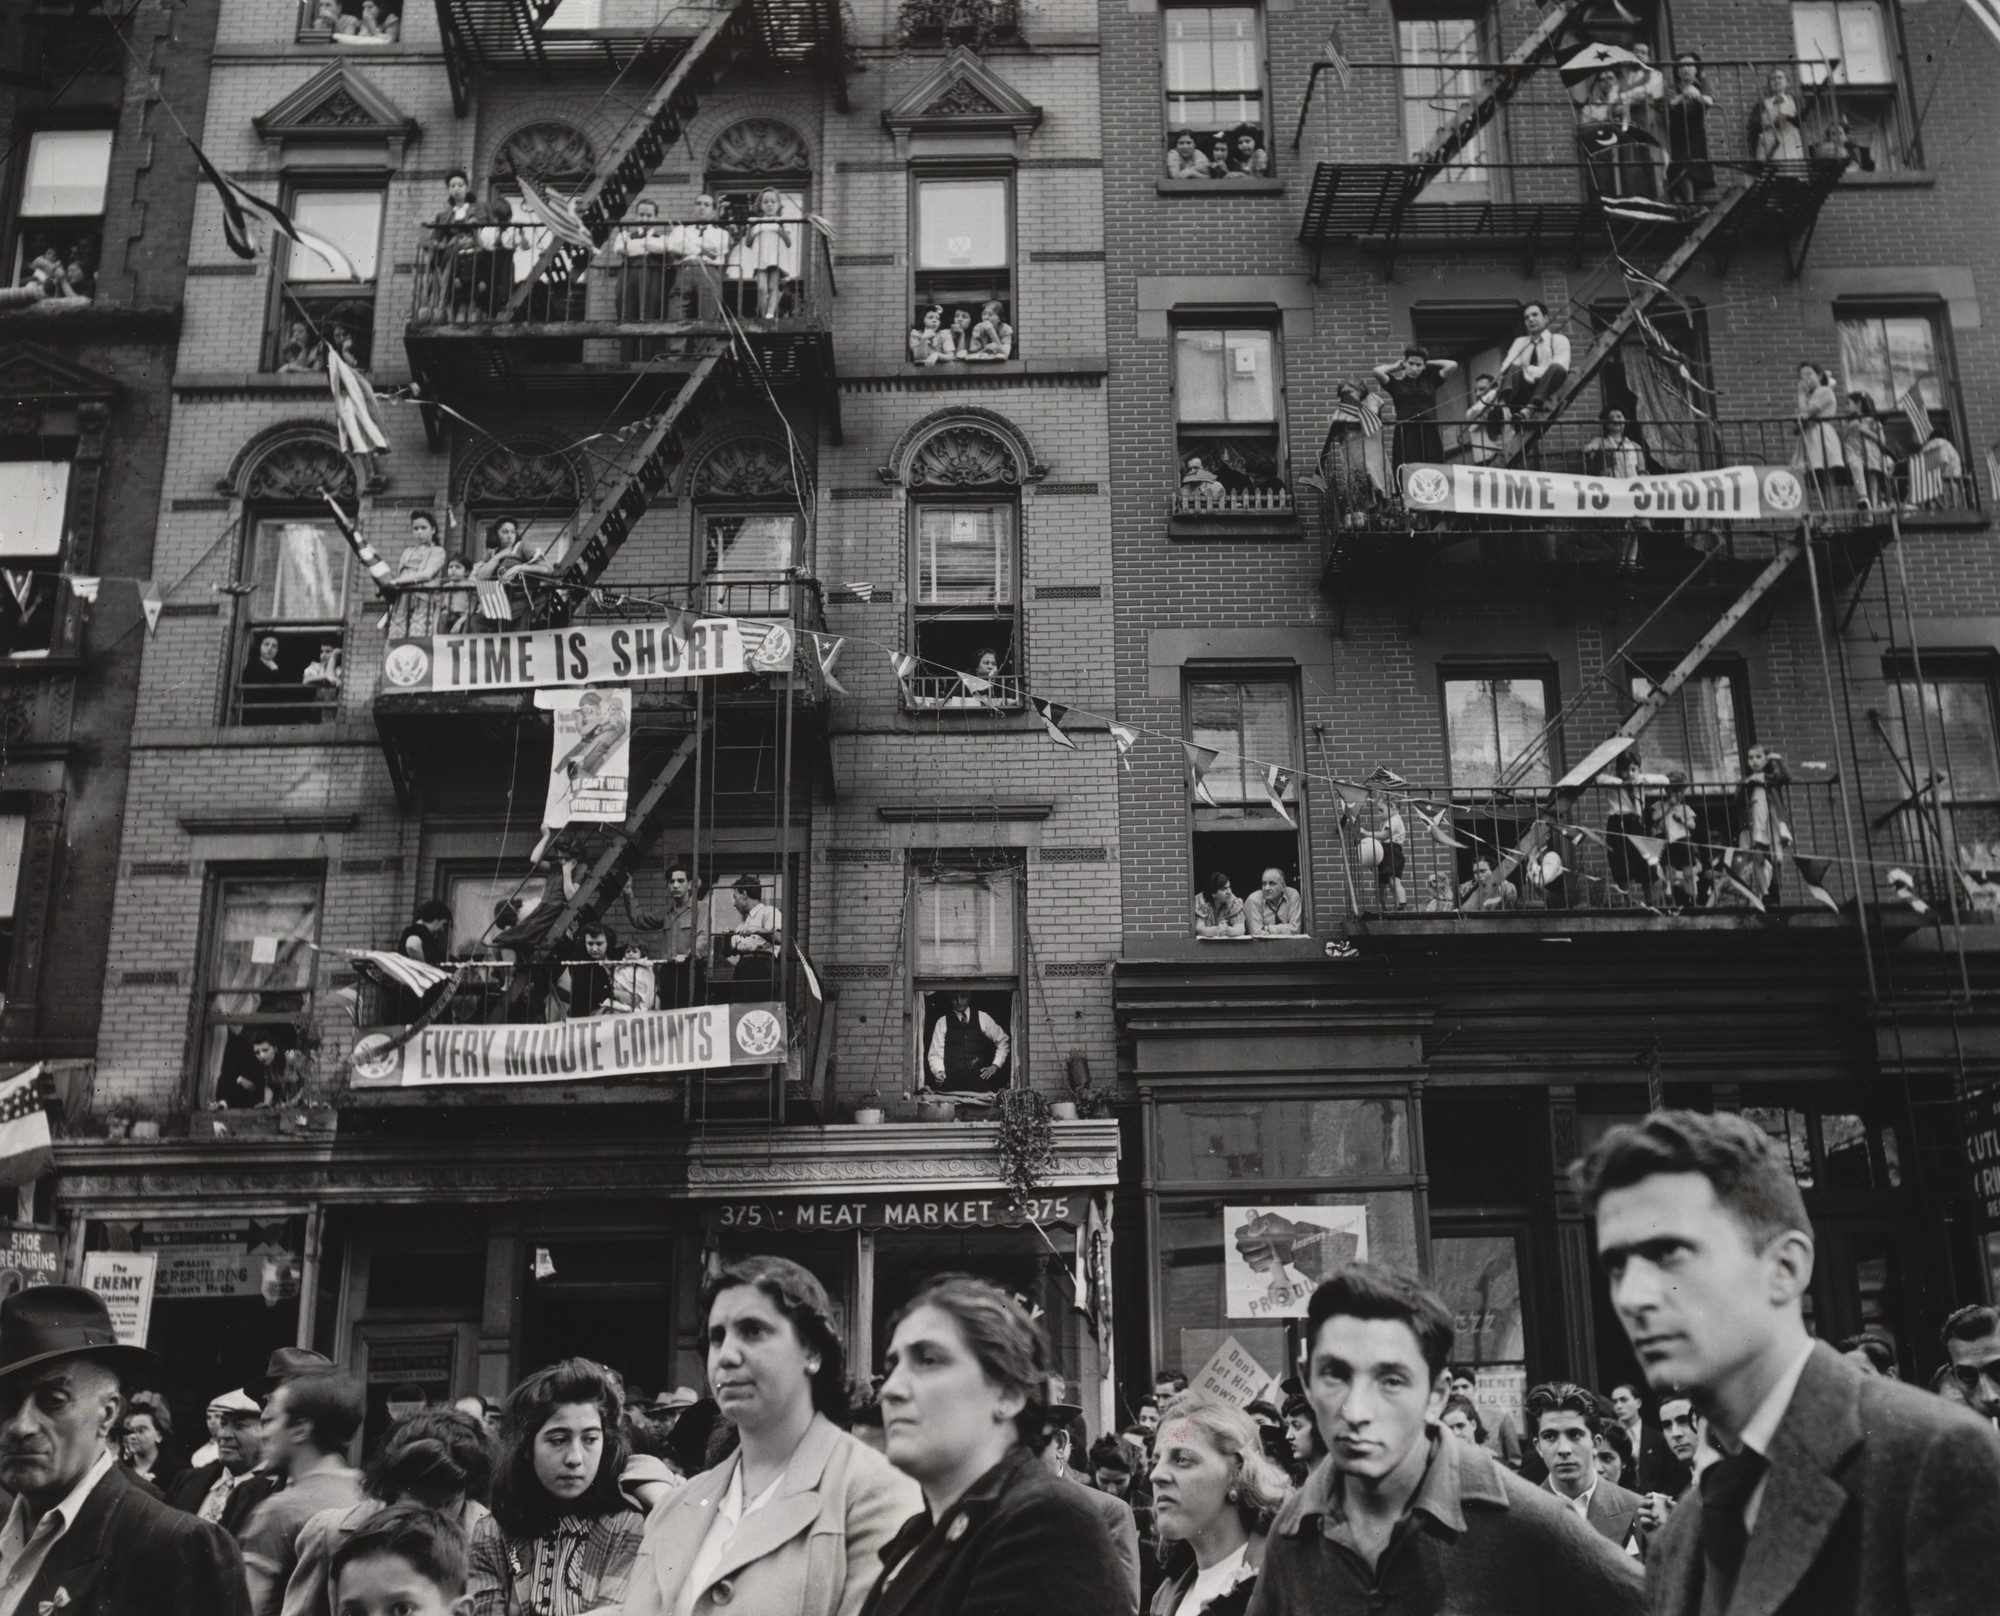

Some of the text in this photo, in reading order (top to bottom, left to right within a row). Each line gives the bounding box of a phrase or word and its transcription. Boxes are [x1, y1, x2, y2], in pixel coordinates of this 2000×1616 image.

[1467, 470, 1555, 511] TIME
[446, 623, 729, 686] TIME IS SHORT
[420, 1010, 713, 1080] EVERY MINUTE COUNTS
[719, 1197, 1070, 1226] 375 MEAT MARKET 375
[11, 1232, 41, 1252] SHOE
[0, 1248, 57, 1272] REPAIRING
[112, 1264, 128, 1273] The
[93, 1276, 142, 1291] ENEMY
[170, 1268, 248, 1284] REBUILDING
[1228, 1349, 1256, 1378] Don't
[1203, 1377, 1245, 1407] Down!
[1211, 1359, 1255, 1398] Let Him
